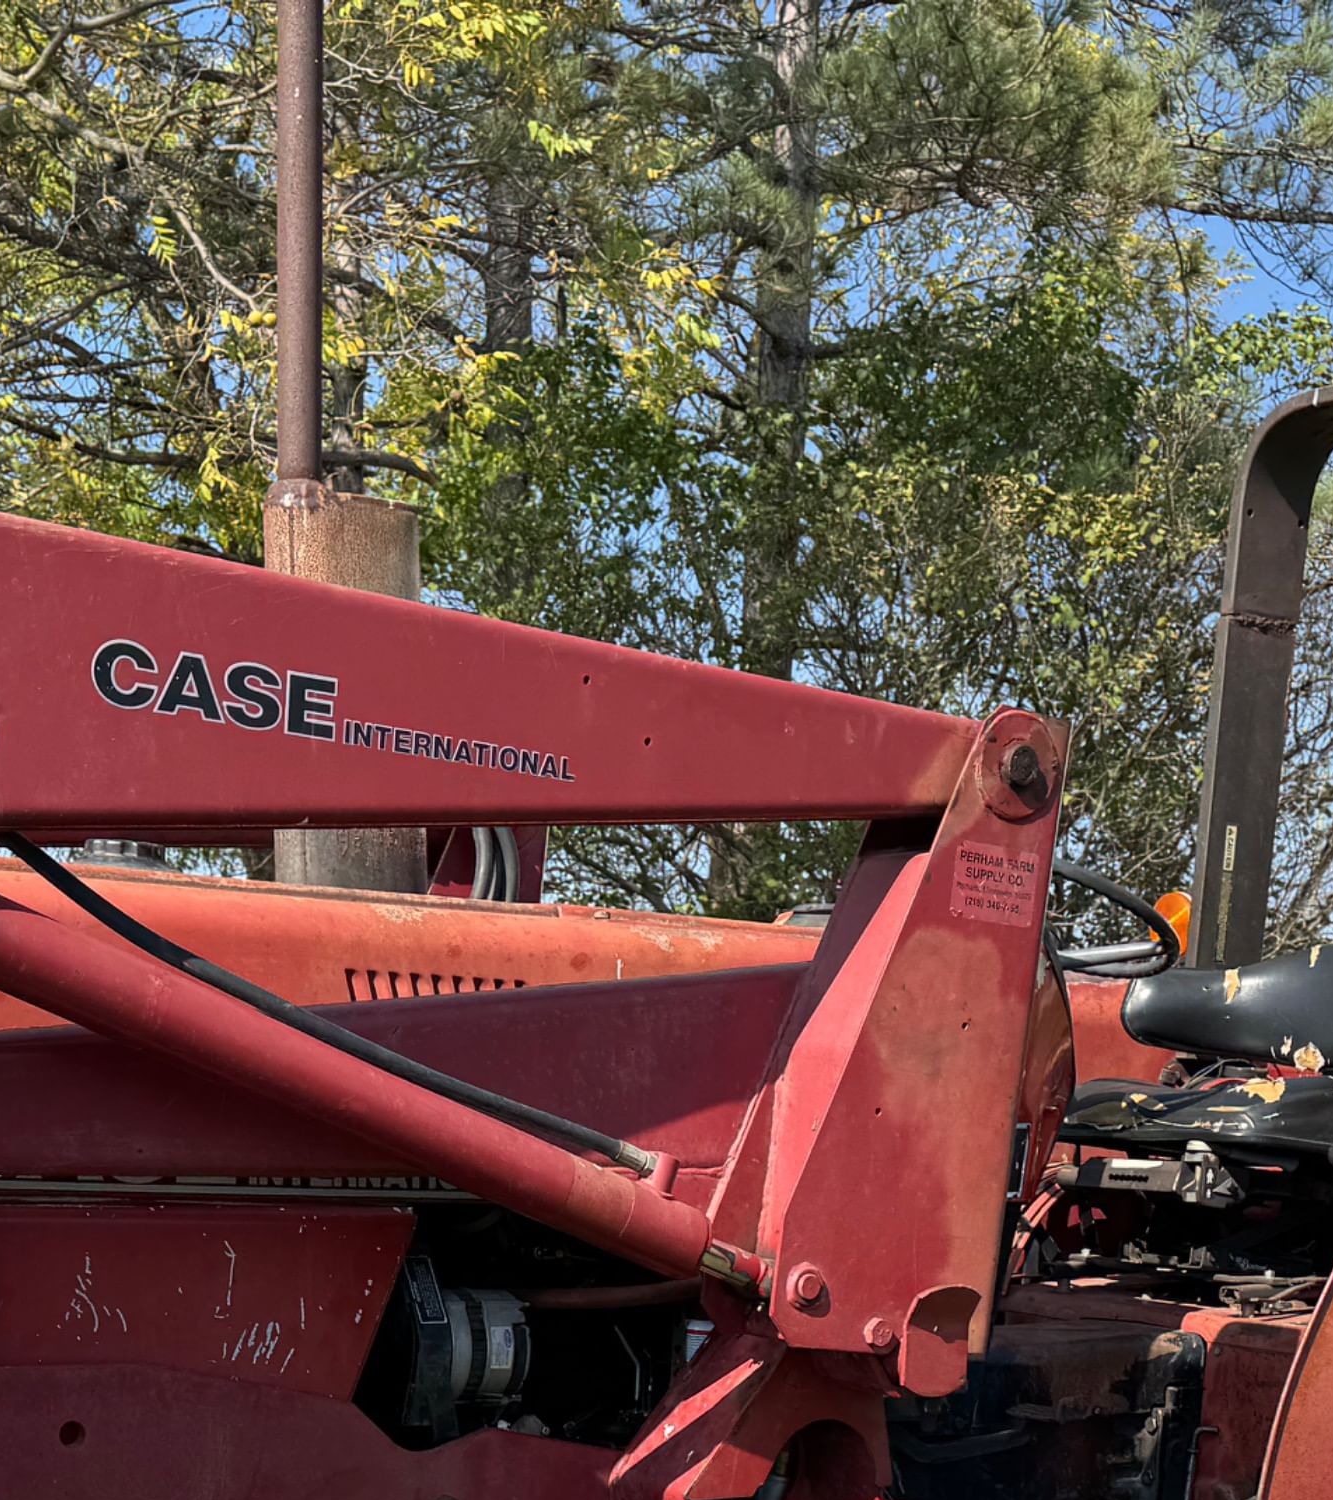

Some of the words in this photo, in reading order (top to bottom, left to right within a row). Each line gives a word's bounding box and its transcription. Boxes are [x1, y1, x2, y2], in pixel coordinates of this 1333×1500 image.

[92, 639, 338, 742] CASE
[343, 719, 575, 782] INTERNATIONAL
[960, 850, 1004, 868] PERHAM
[1007, 858, 1035, 873] FARM
[965, 866, 1005, 883] SUPPLY
